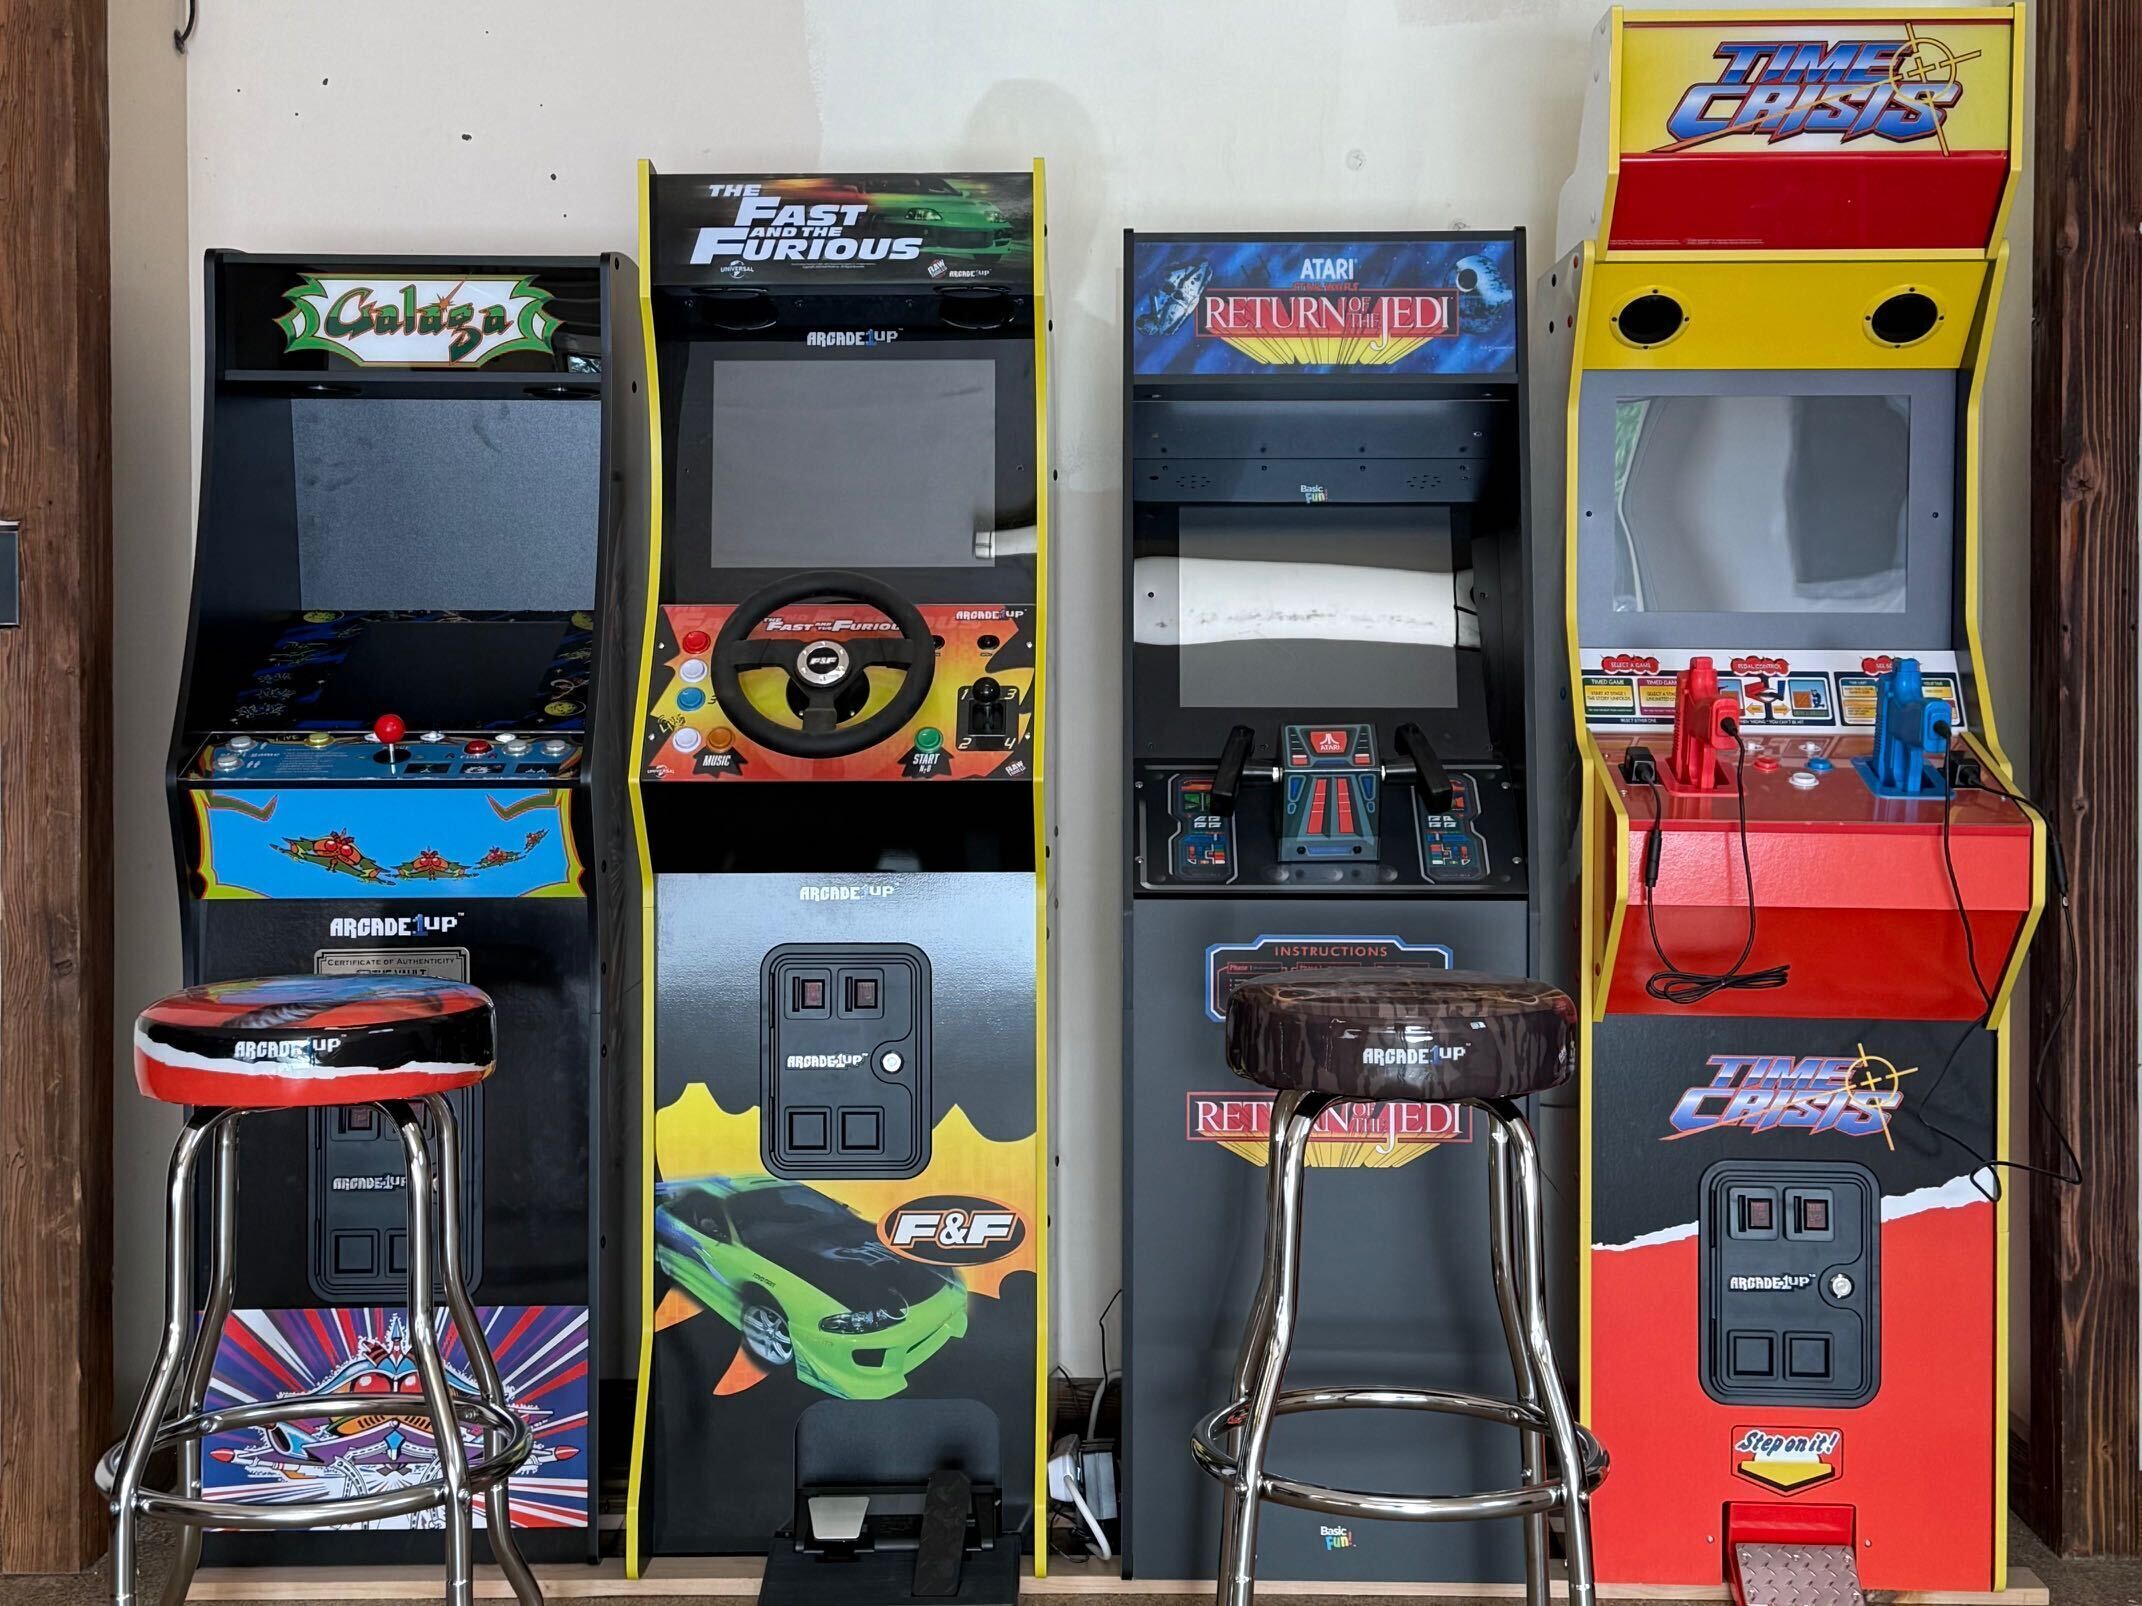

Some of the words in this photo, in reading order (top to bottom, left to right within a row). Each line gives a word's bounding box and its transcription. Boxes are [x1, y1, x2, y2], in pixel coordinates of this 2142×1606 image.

[1713, 41, 1913, 84] TIME
[1667, 80, 1963, 144] CRISIS
[709, 184, 762, 197] THE
[734, 196, 868, 226] FAST
[749, 226, 801, 238] AND
[801, 226, 843, 238] THE
[689, 227, 924, 264] FURIOUS
[720, 265, 755, 274] UNIVERSAL
[1300, 258, 1354, 280] ATARI
[1348, 297, 1371, 312] OF
[1205, 296, 1346, 329] RETURN
[324, 283, 514, 365] Galaga
[1349, 313, 1380, 328] THE
[1370, 296, 1449, 351] JEDI
[1300, 484, 1324, 493] Basic
[766, 621, 814, 631] FAST
[961, 689, 968, 700] 1
[1004, 688, 1017, 700] 3
[958, 738, 972, 749] 2
[1004, 738, 1016, 749] 4
[702, 755, 731, 766] MUSIC
[912, 754, 940, 764] START
[1274, 946, 1388, 957] INSTRUCTIONS
[327, 959, 381, 967] CERTIFICATE
[396, 957, 456, 966] AUTHENTICITY
[1706, 1055, 1864, 1089] TIME
[1352, 1102, 1376, 1117] OF
[1668, 1087, 1904, 1136] CRISIS
[1351, 1118, 1386, 1132] THE
[1375, 1101, 1463, 1155] JEDI
[892, 1211, 1016, 1247] F&F
[1736, 1430, 1784, 1457] Step
[1784, 1438, 1808, 1454] on
[1808, 1432, 1839, 1454] it!
[1320, 1525, 1347, 1536] Basic
